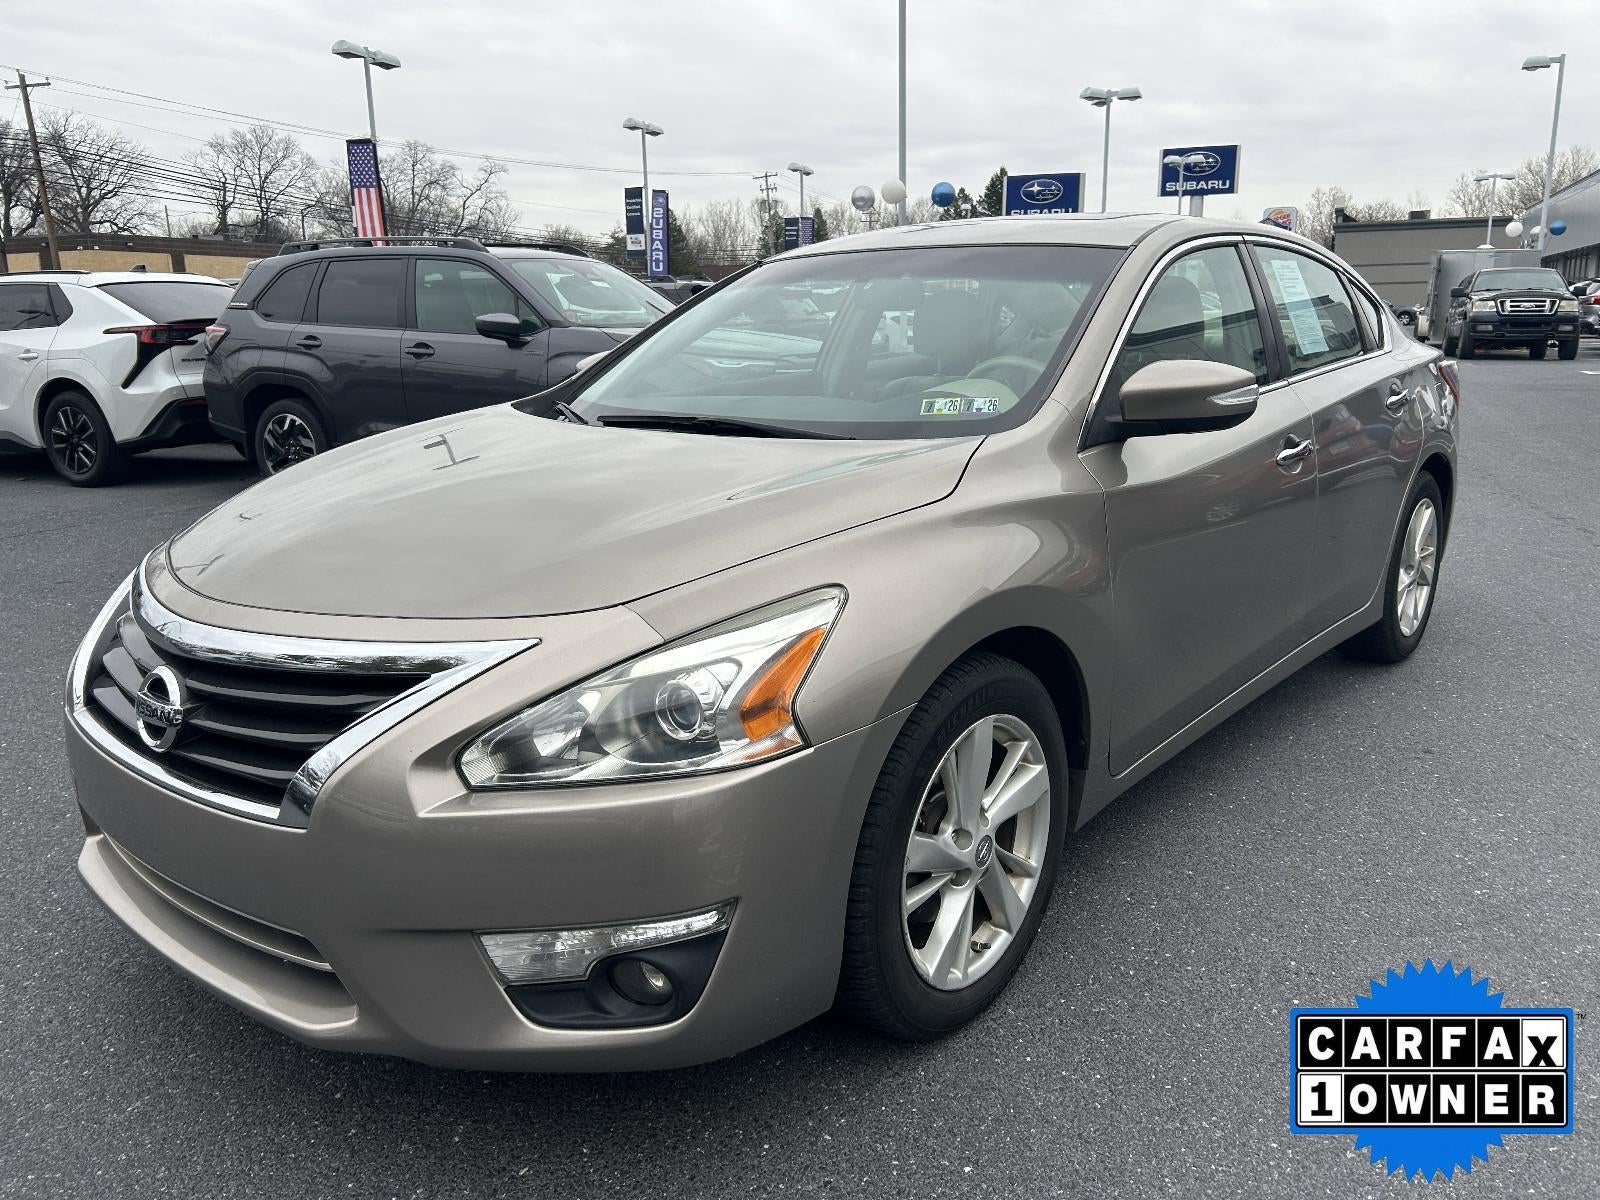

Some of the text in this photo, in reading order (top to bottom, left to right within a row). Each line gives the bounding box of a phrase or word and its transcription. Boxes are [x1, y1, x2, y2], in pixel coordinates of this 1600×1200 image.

[1165, 180, 1230, 191] SUBARU
[947, 399, 959, 412] 26
[987, 399, 998, 412] 26
